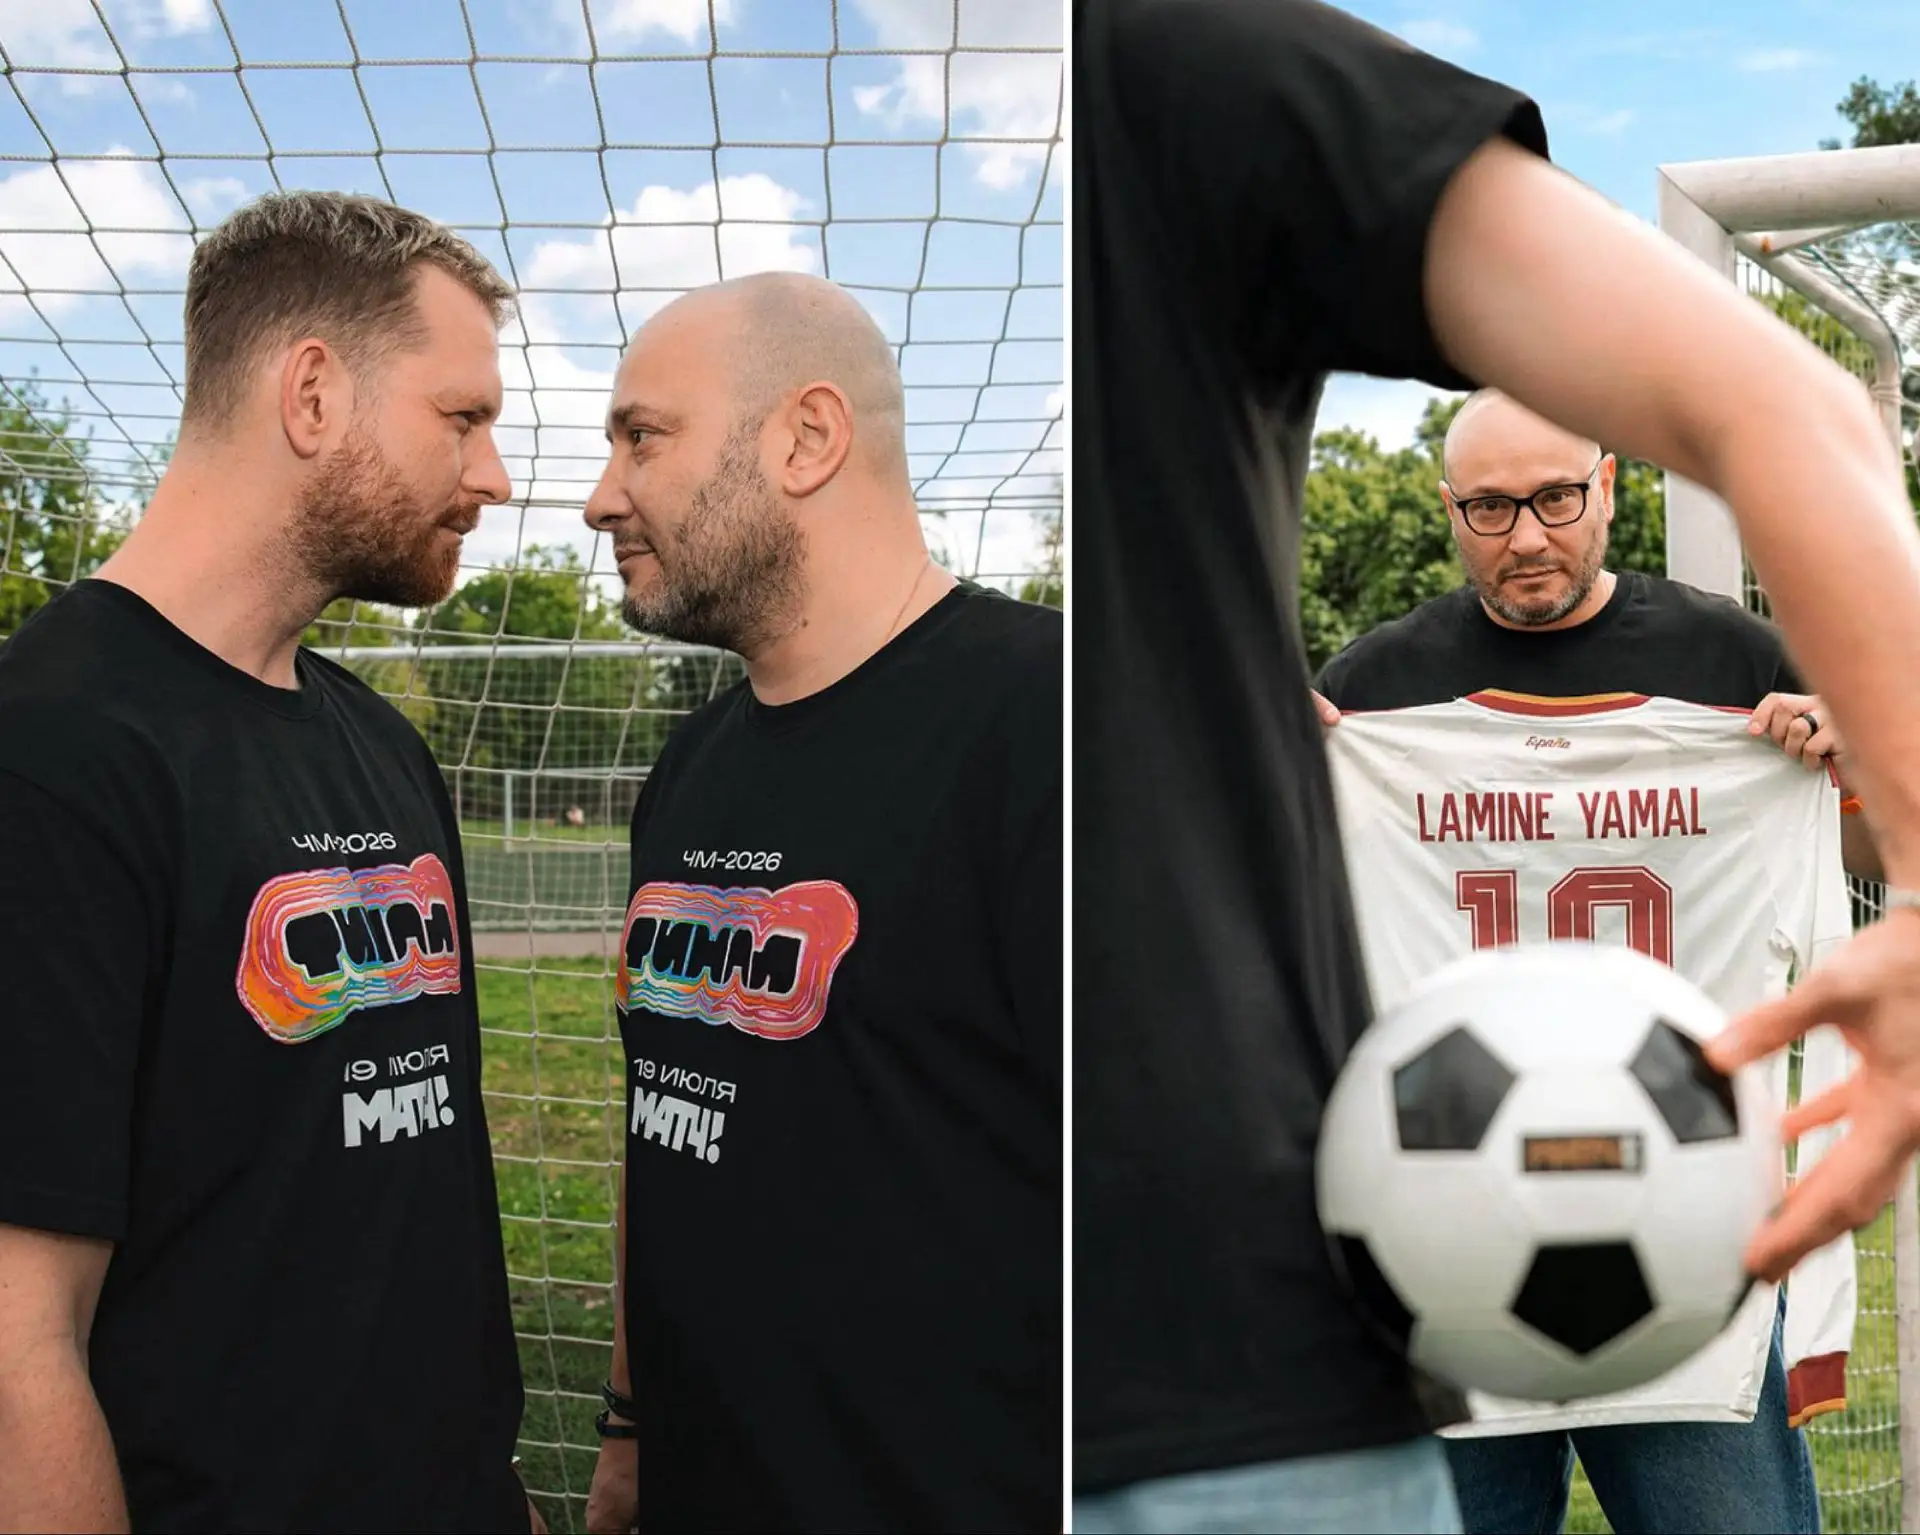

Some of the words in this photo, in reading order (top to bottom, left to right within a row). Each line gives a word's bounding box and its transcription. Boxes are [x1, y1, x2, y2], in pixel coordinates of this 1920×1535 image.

[1416, 791, 1555, 842] LAMINE
[1577, 786, 1707, 839] YAMAL
[683, 850, 782, 872] ЧМ-2026
[633, 1058, 656, 1080] 19
[660, 1065, 737, 1104] ИЮЛЯ
[631, 1086, 725, 1165] МАТЧ!
